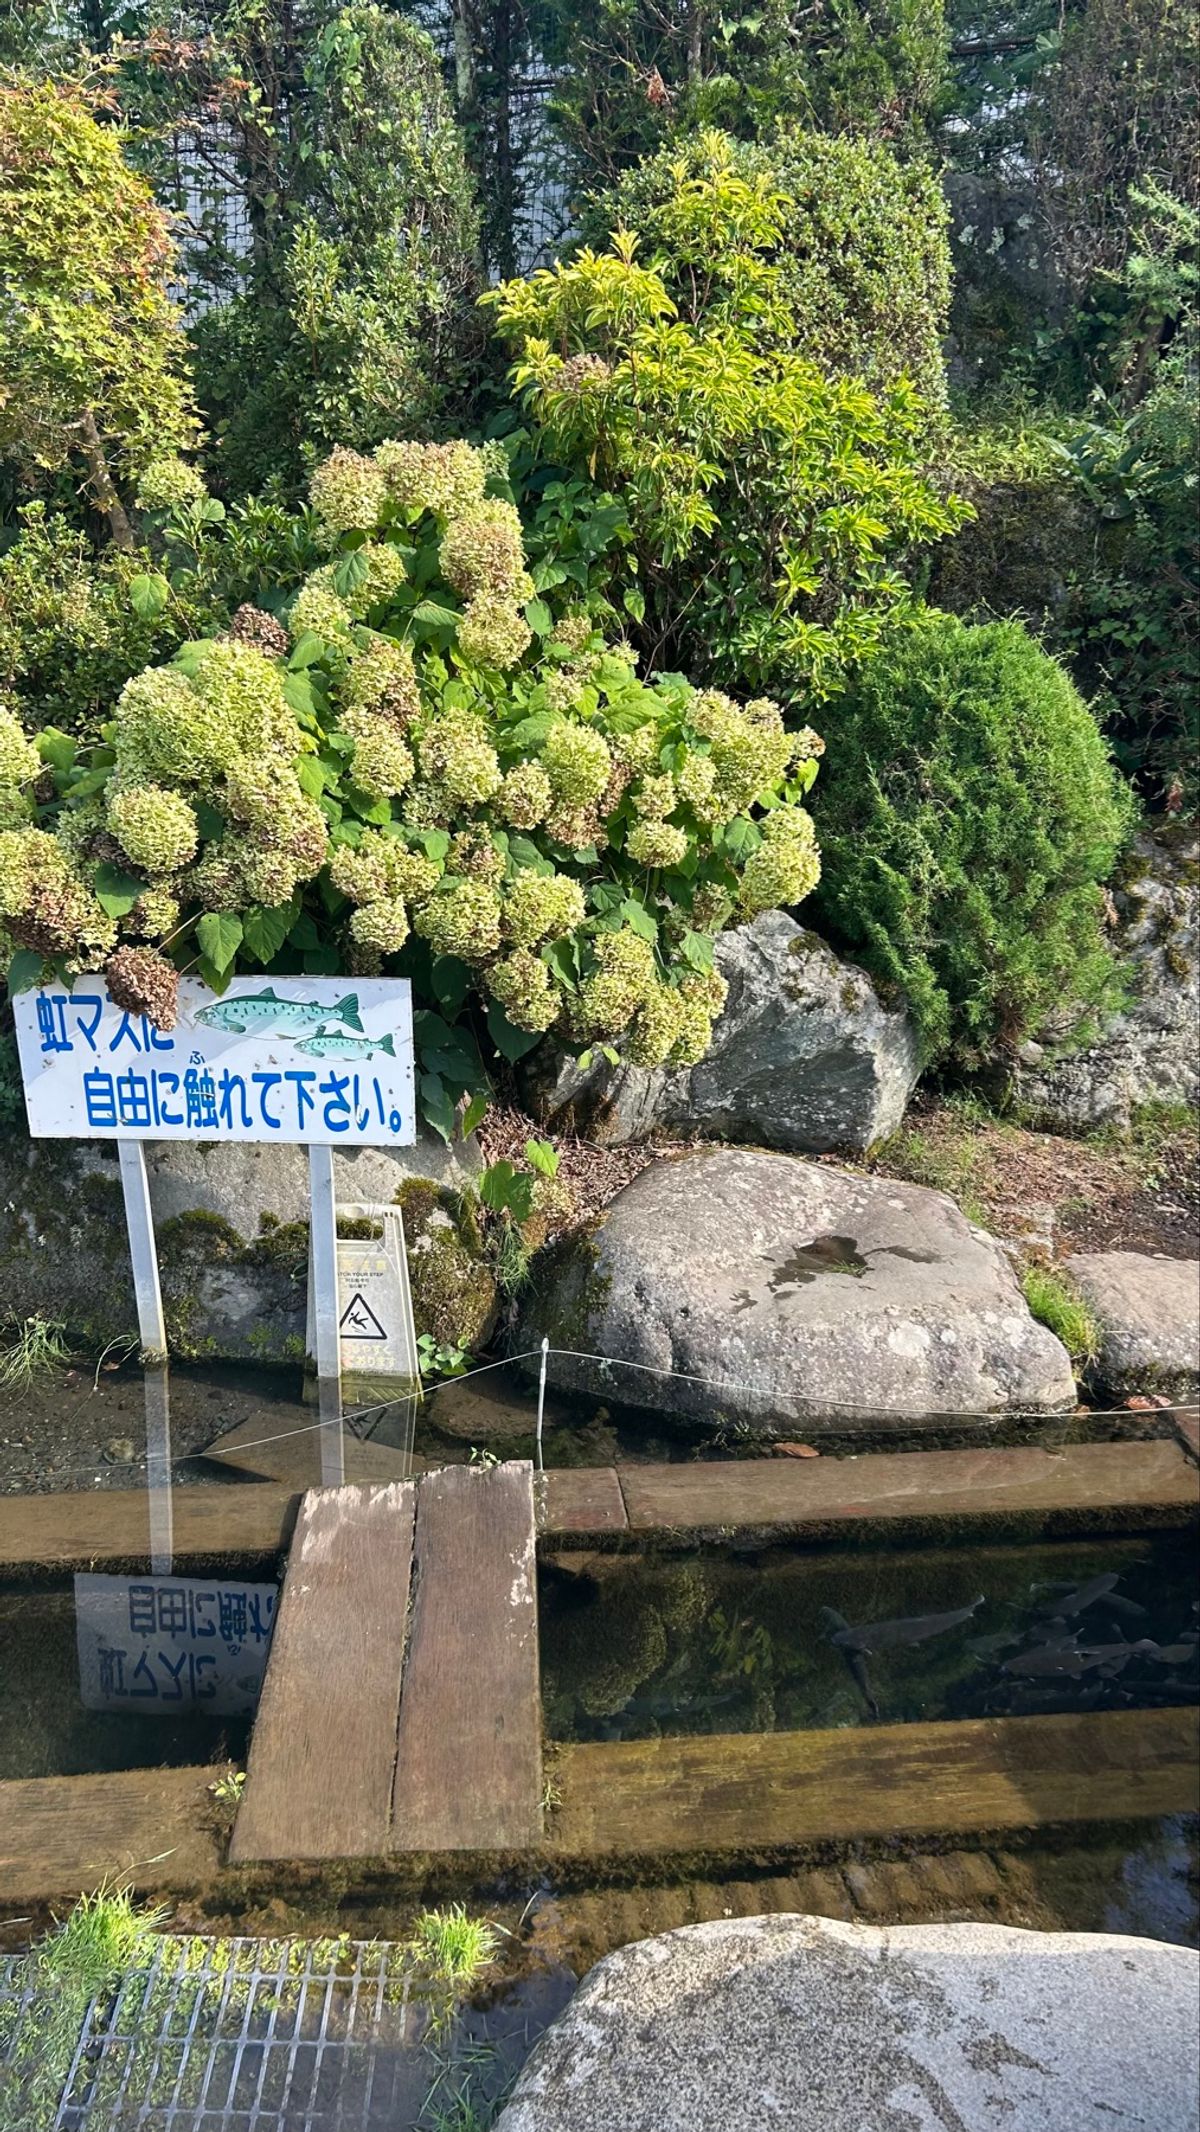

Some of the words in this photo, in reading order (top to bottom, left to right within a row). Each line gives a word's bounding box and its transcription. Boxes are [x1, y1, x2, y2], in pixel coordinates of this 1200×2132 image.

[189, 1050, 206, 1065] ふ
[83, 1066, 402, 1133] 自由に触れて下さい。
